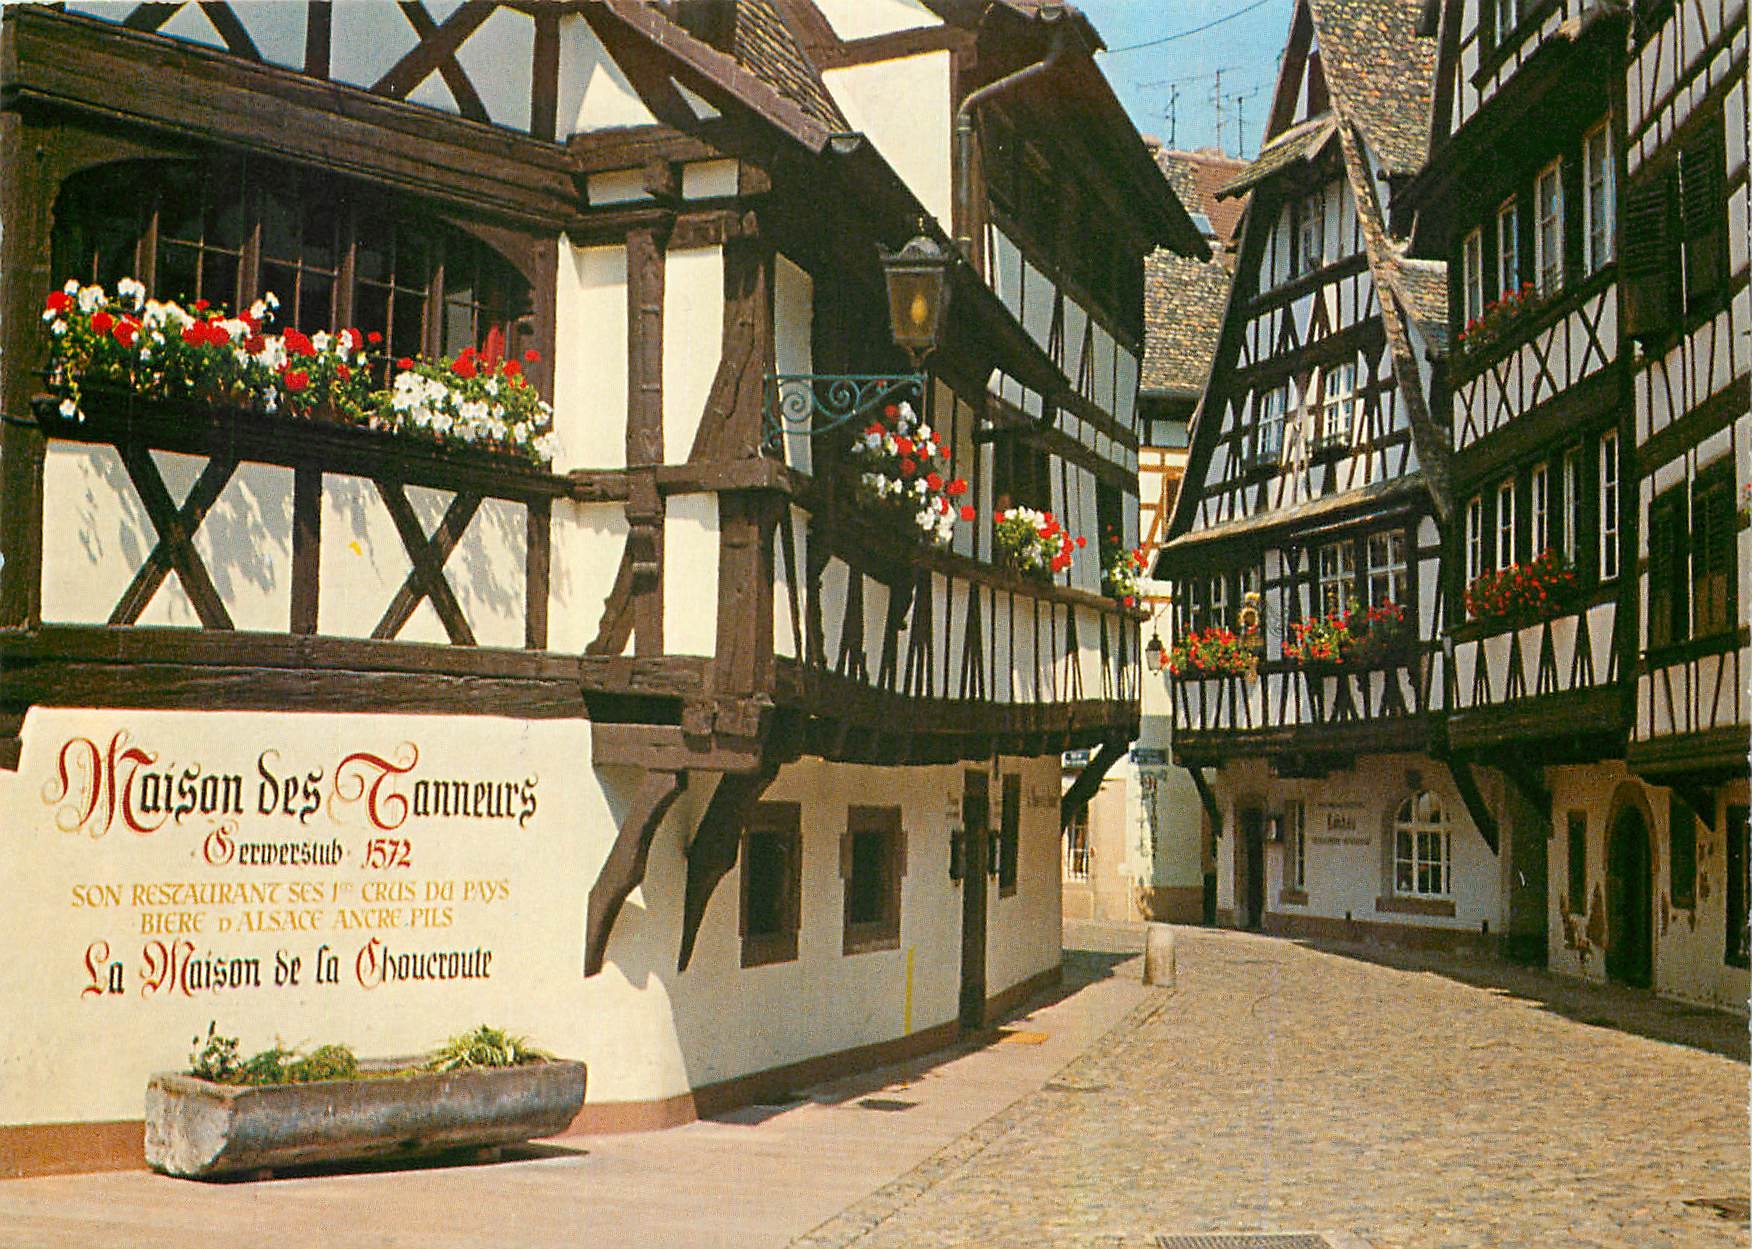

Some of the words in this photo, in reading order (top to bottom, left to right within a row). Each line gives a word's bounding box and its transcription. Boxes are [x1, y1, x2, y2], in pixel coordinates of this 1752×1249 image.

[41, 728, 243, 839] Maison
[257, 748, 324, 824] des
[327, 740, 538, 830] Tanneurs
[361, 838, 413, 869] 1572
[72, 884, 122, 908] SON
[132, 882, 282, 907] RESTAURANT
[287, 882, 325, 903] SES
[361, 880, 417, 902] CRUS
[425, 880, 453, 901] DU
[463, 878, 511, 904] PAYS
[80, 939, 125, 999] La
[139, 938, 261, 999] Maison
[275, 949, 301, 986] de
[317, 944, 339, 984] la
[355, 936, 492, 989] Choucroute
